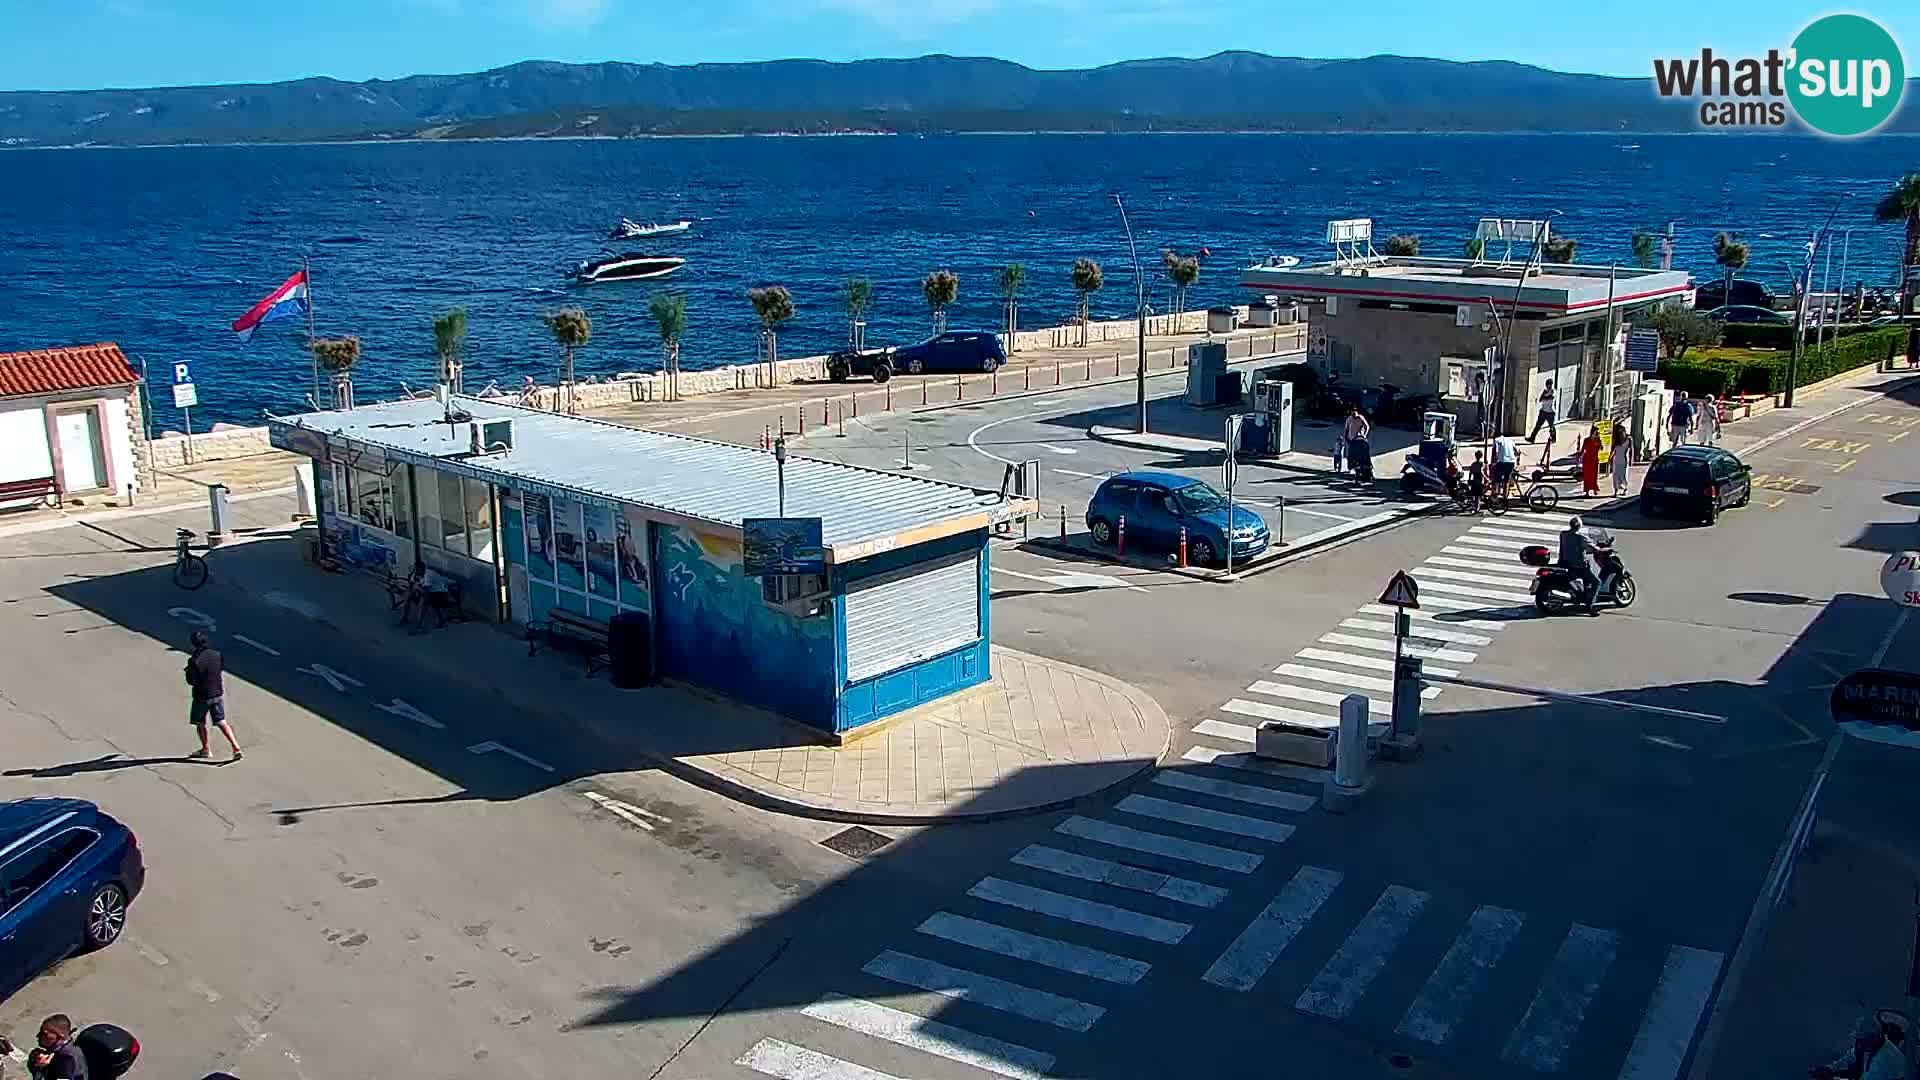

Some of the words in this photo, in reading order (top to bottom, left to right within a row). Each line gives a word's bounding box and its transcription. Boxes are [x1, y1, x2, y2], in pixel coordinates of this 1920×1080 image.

[175, 363, 188, 382] P
[1799, 437, 1872, 454] TAXI
[1750, 475, 1805, 491] AXI
